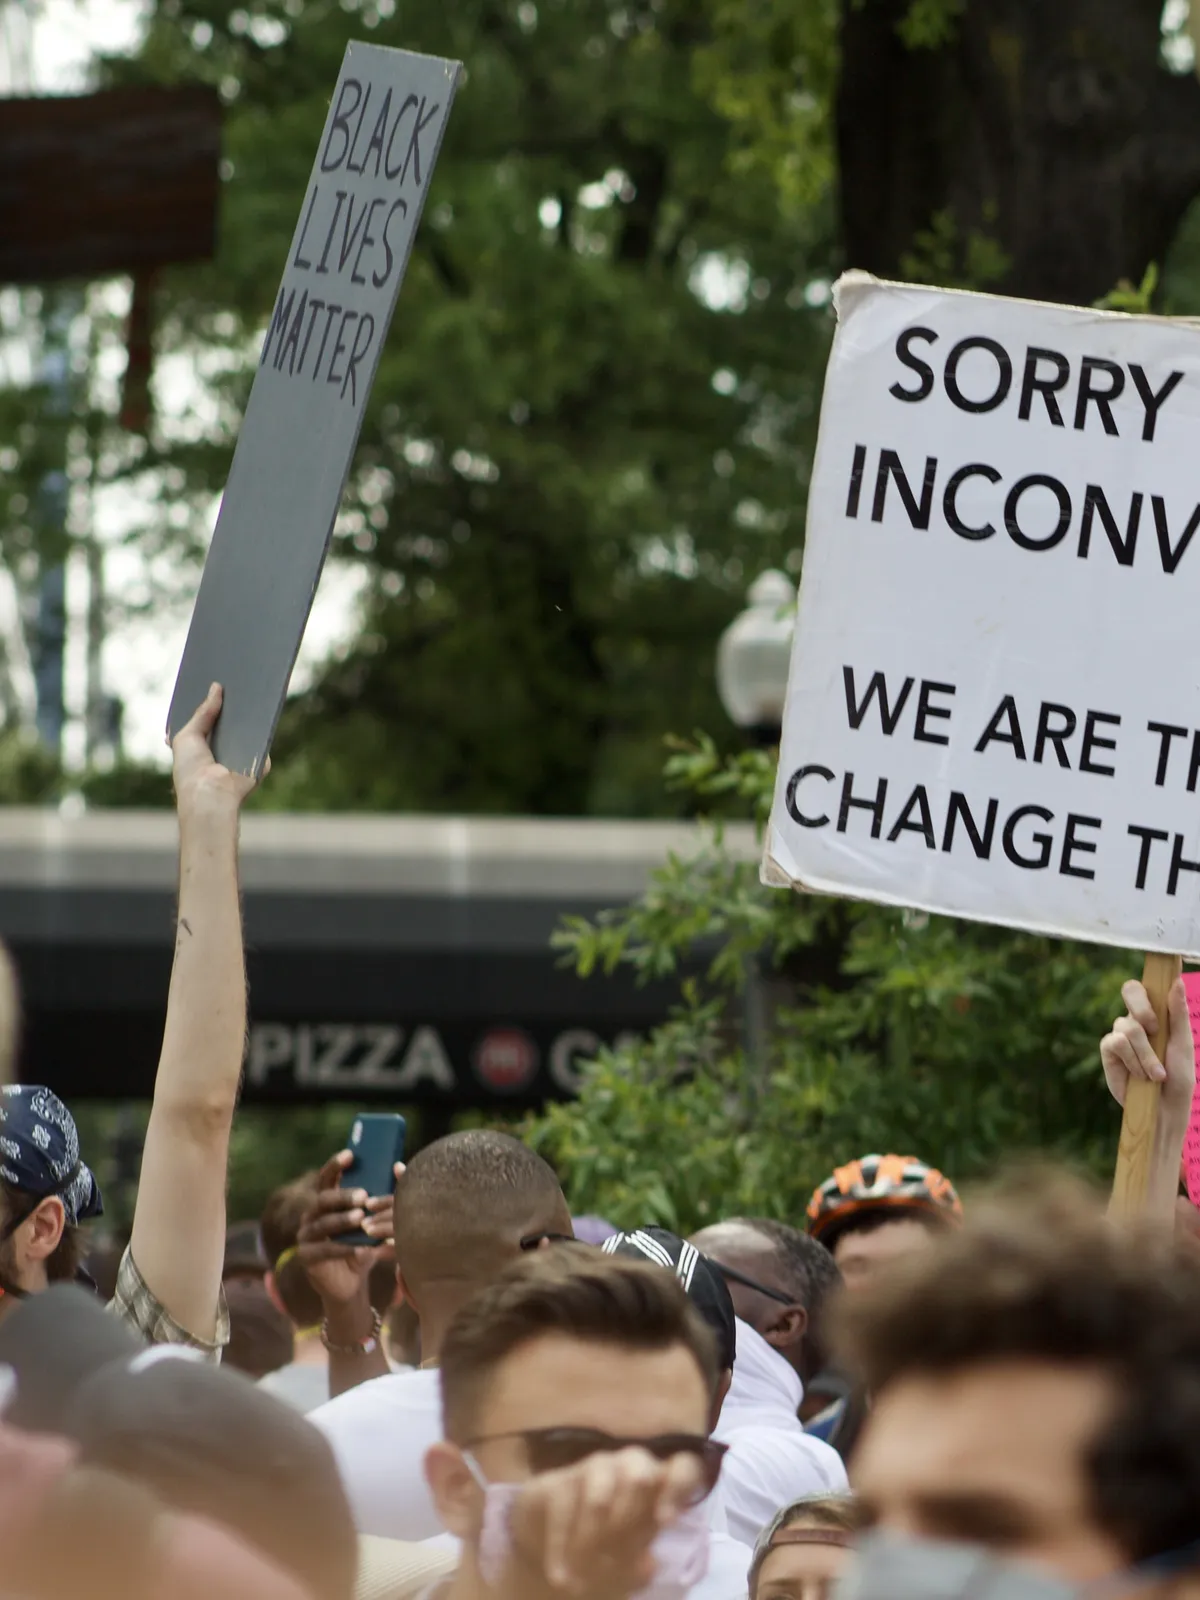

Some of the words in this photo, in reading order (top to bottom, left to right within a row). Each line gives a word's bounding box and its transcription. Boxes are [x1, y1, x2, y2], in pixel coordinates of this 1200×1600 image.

[320, 78, 440, 187] BLACK
[293, 184, 408, 289] LIVES
[260, 287, 376, 407] MATTER
[889, 327, 1184, 441] SORRY
[843, 666, 956, 745] WE
[975, 695, 1121, 776] ARE
[786, 765, 1101, 879] CHANGE
[249, 1023, 454, 1089] PIZZA
